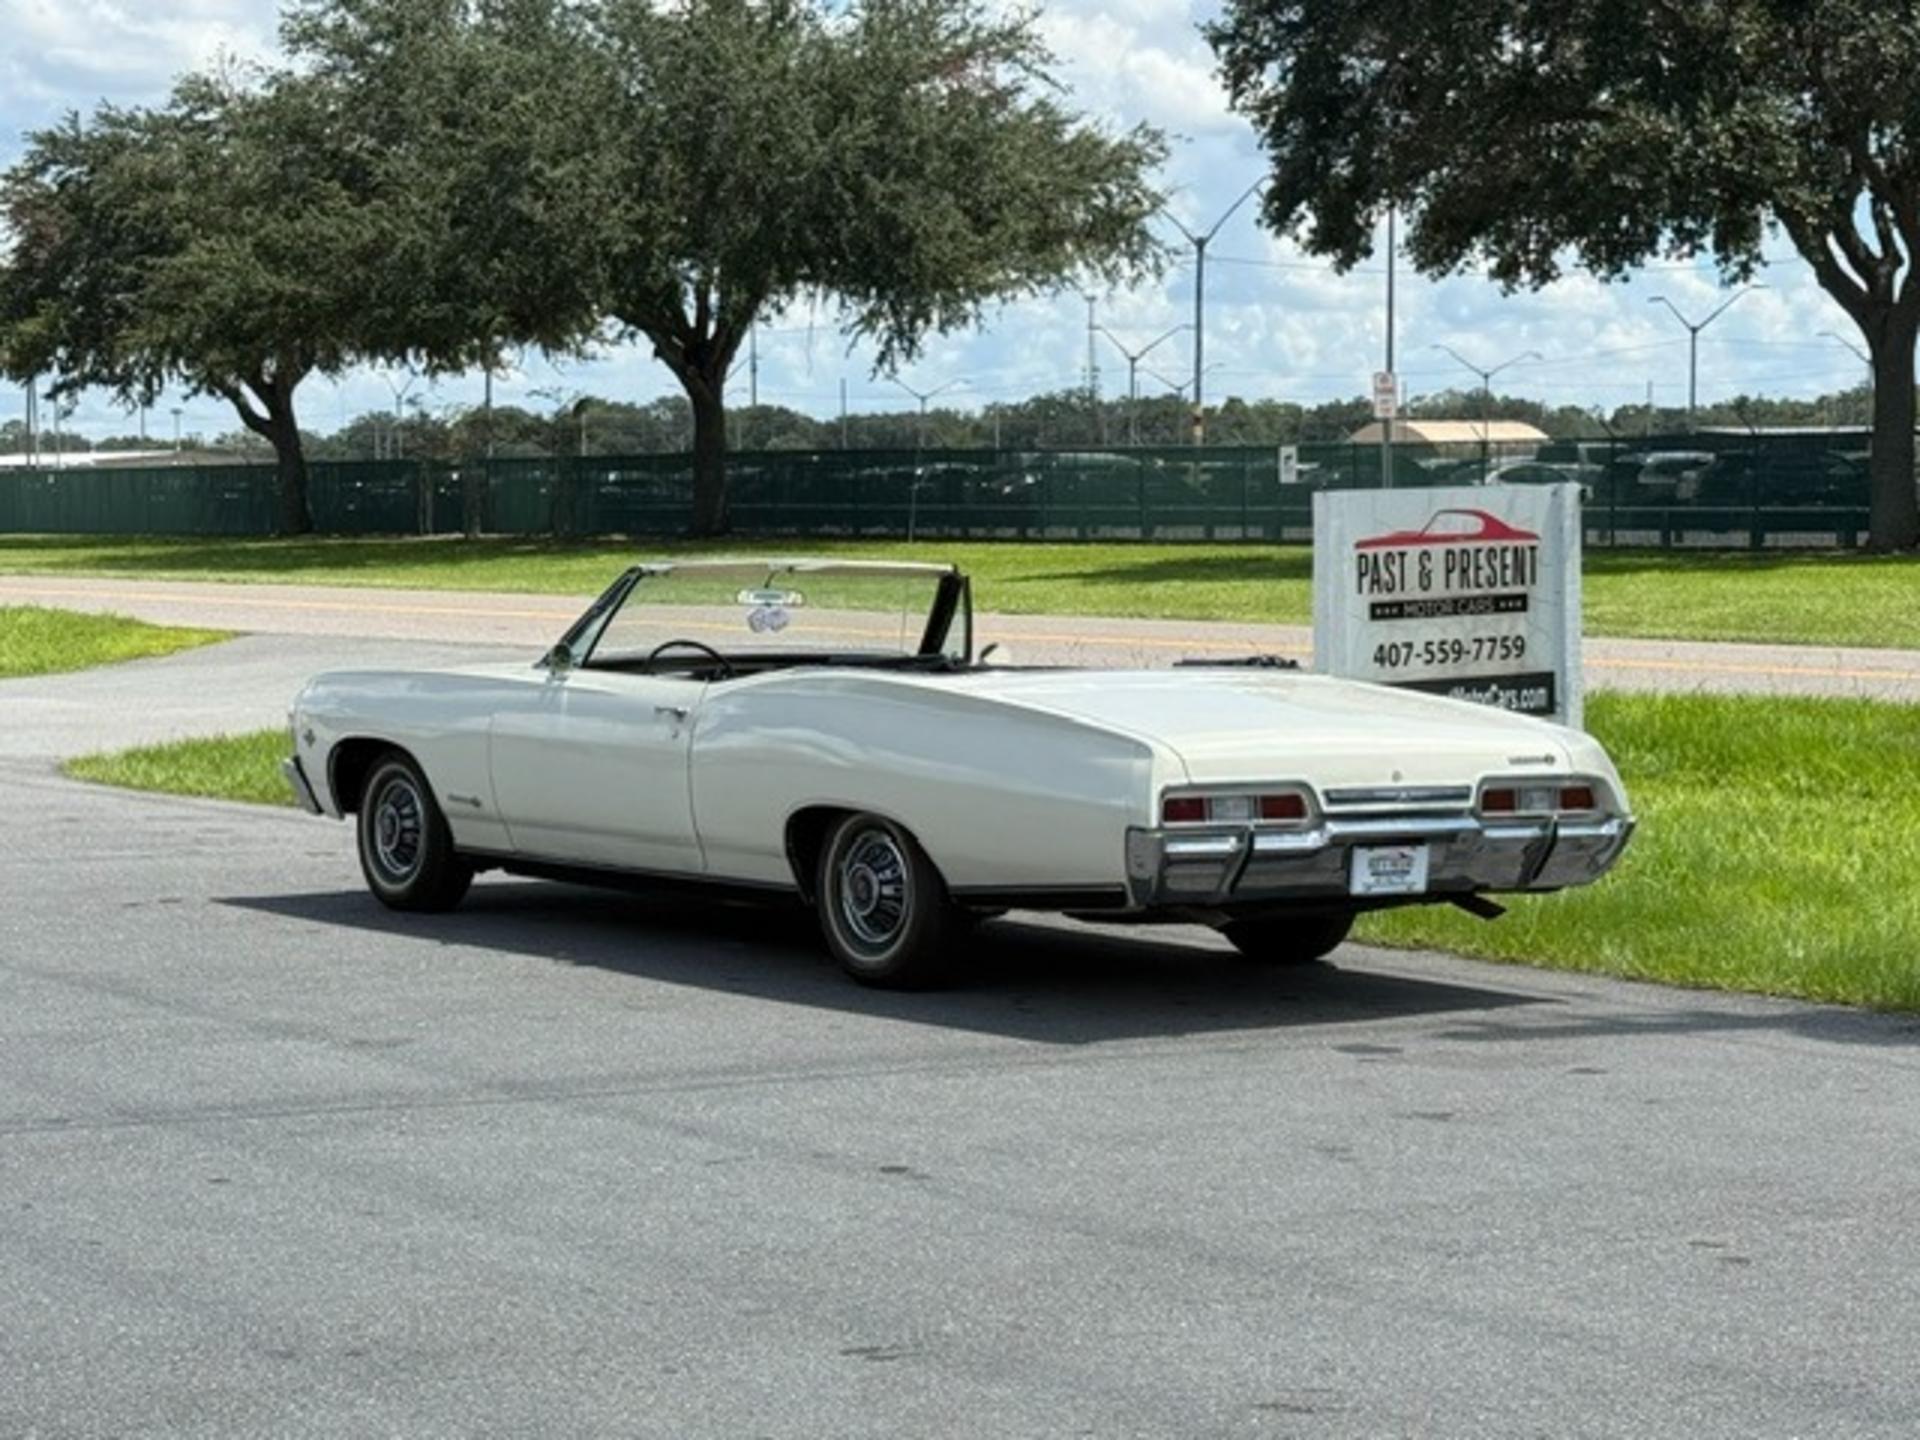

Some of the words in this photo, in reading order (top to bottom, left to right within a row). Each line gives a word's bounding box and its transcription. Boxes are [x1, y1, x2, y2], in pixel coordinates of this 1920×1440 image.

[1357, 551, 1407, 594] PAST
[1418, 550, 1432, 591] &
[1445, 546, 1538, 590] PRESENT
[1403, 601, 1453, 618] MOTOR
[1457, 597, 1494, 614] CARS
[1373, 635, 1525, 668] 407-559-7759
